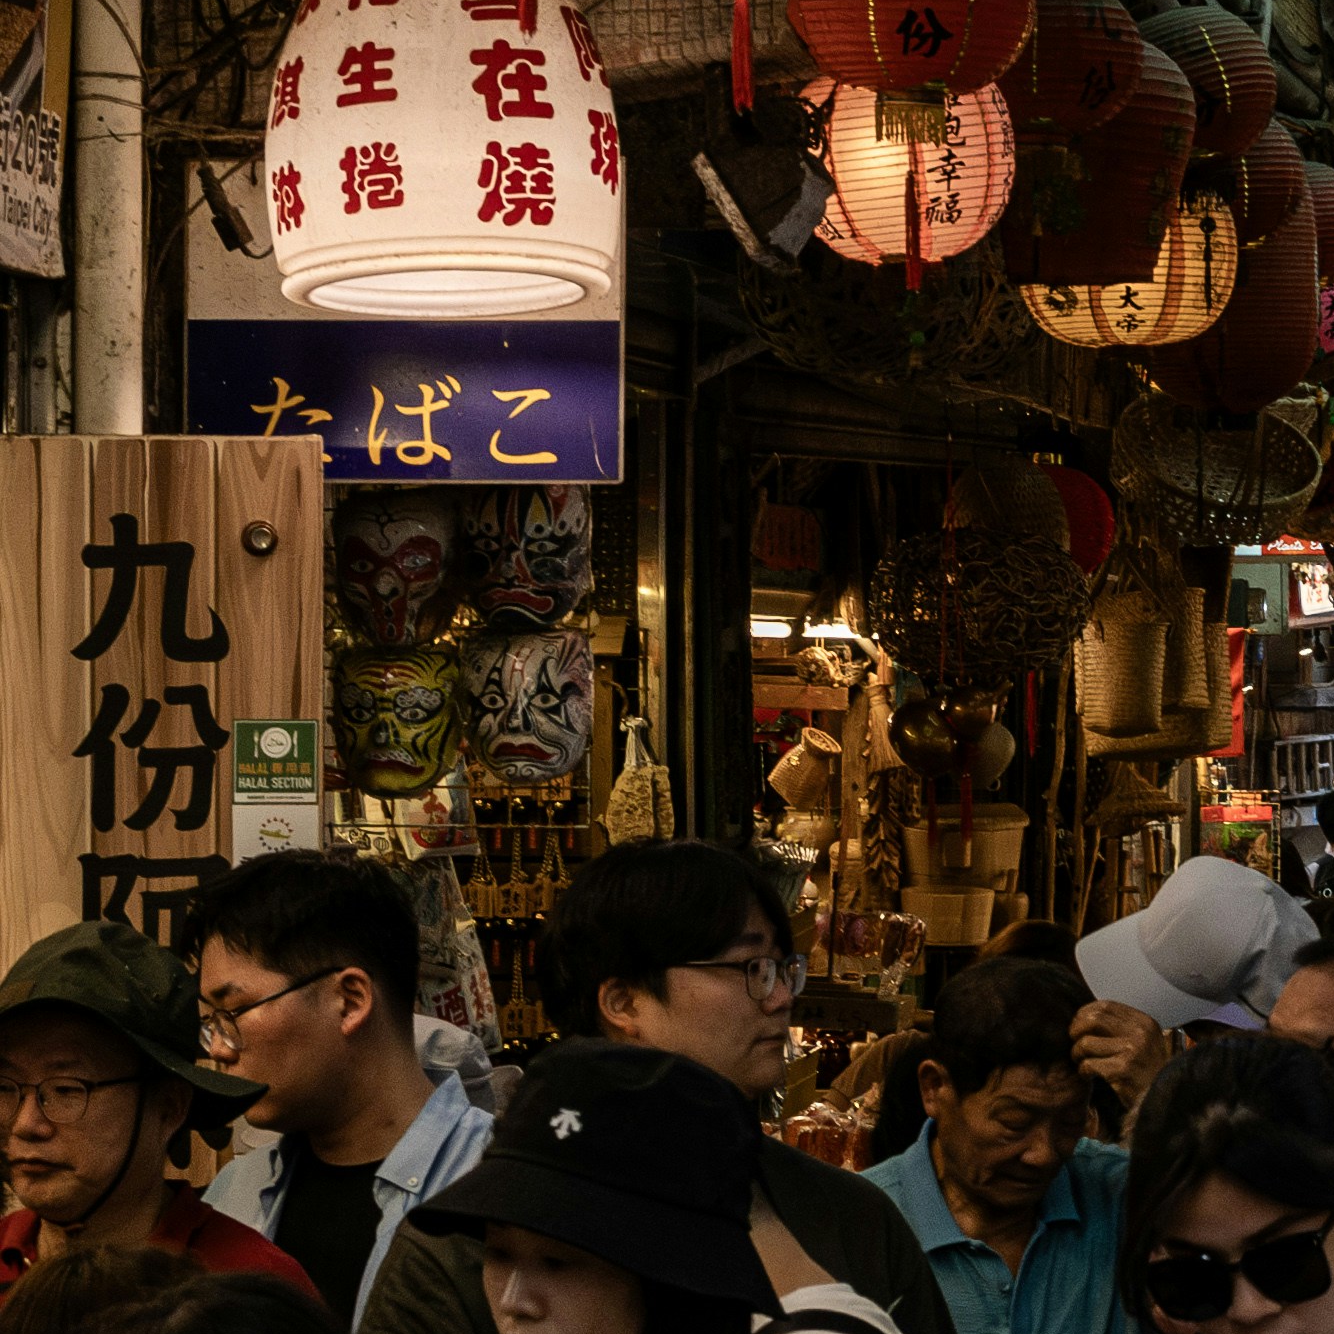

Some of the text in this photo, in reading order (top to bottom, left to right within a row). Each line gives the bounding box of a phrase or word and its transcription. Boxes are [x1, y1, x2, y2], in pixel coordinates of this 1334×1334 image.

[250, 374, 558, 466] たばこ
[70, 513, 232, 947] 九份阿
[238, 777, 312, 788] HALAL SECTION
